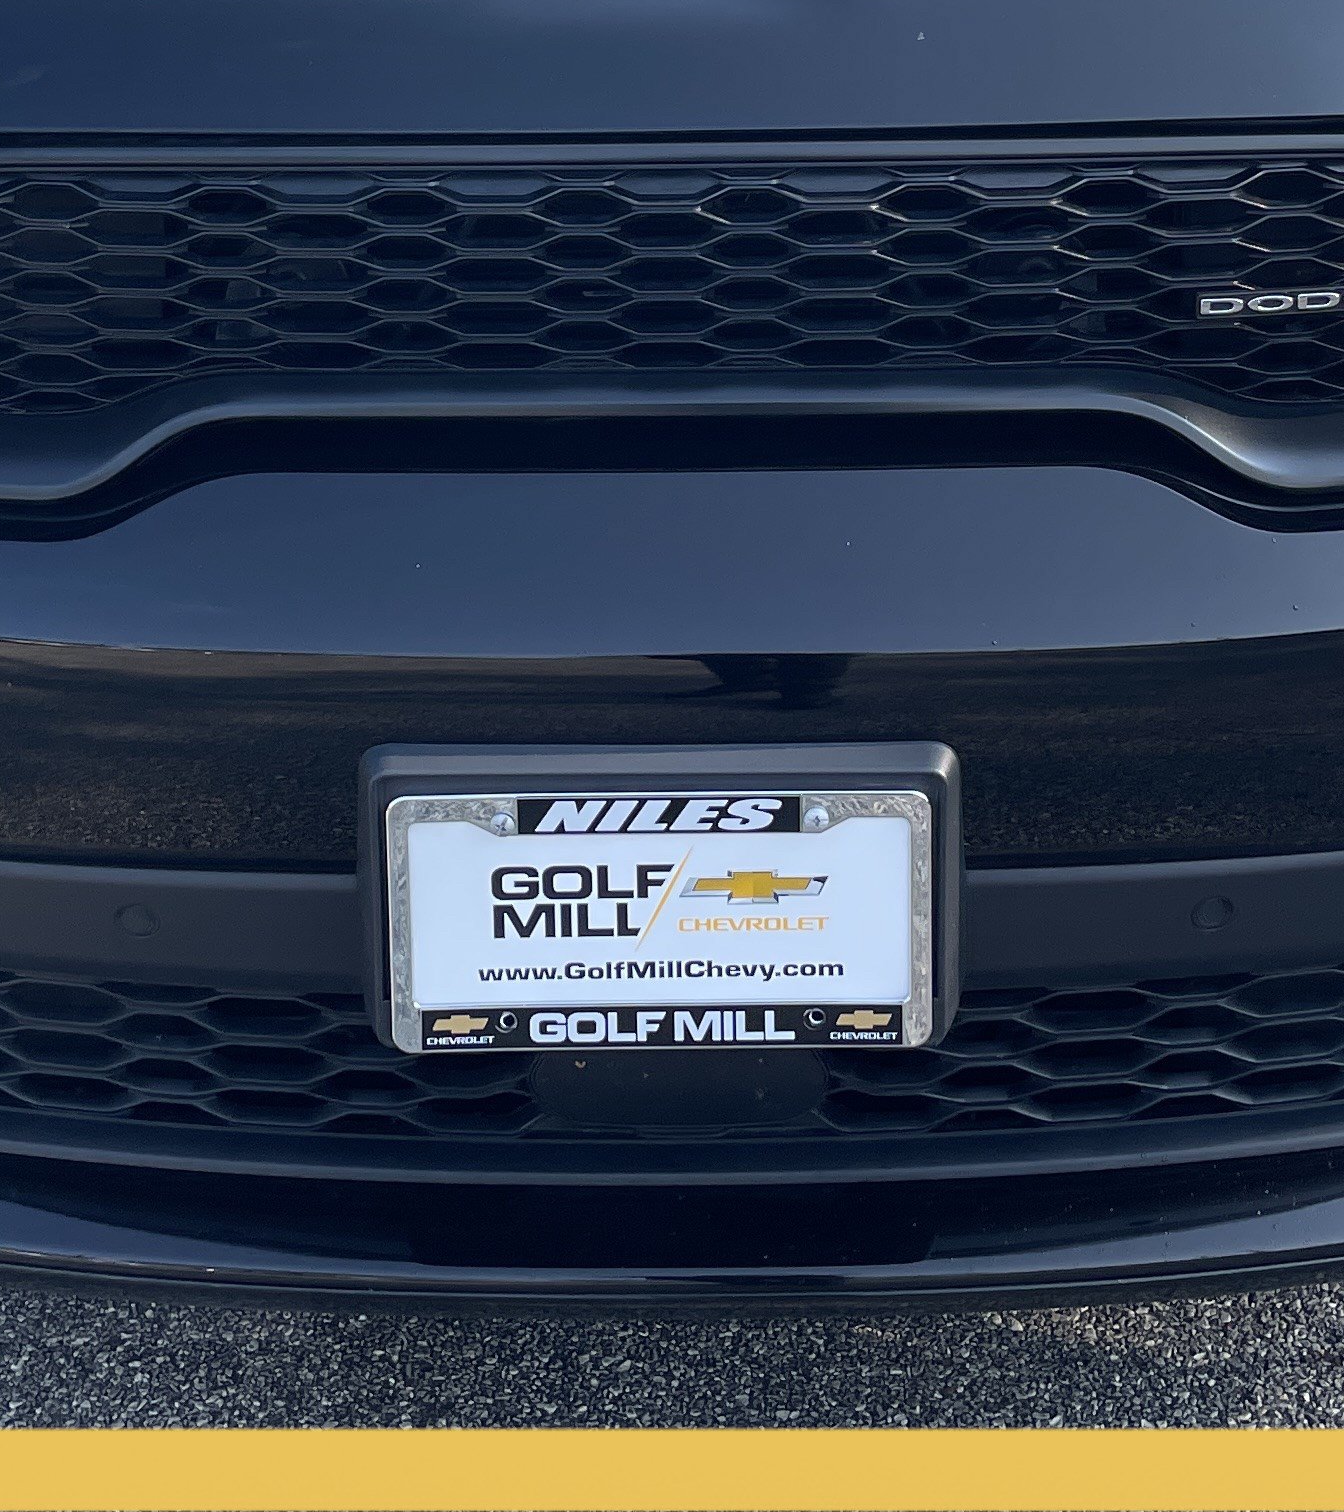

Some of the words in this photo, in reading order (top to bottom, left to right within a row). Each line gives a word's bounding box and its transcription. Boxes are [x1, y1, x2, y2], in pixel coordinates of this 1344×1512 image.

[535, 798, 783, 832] NILES
[490, 864, 676, 901] GOLF
[492, 903, 642, 939] MILL
[678, 916, 830, 932] CHEVROLET
[478, 959, 845, 983] www.GolfMillChevy.com
[426, 1035, 495, 1046] CHEVROLET
[529, 1011, 666, 1043] GOLF
[674, 1010, 796, 1041] MILL
[829, 1031, 898, 1041] CHEVROLET
